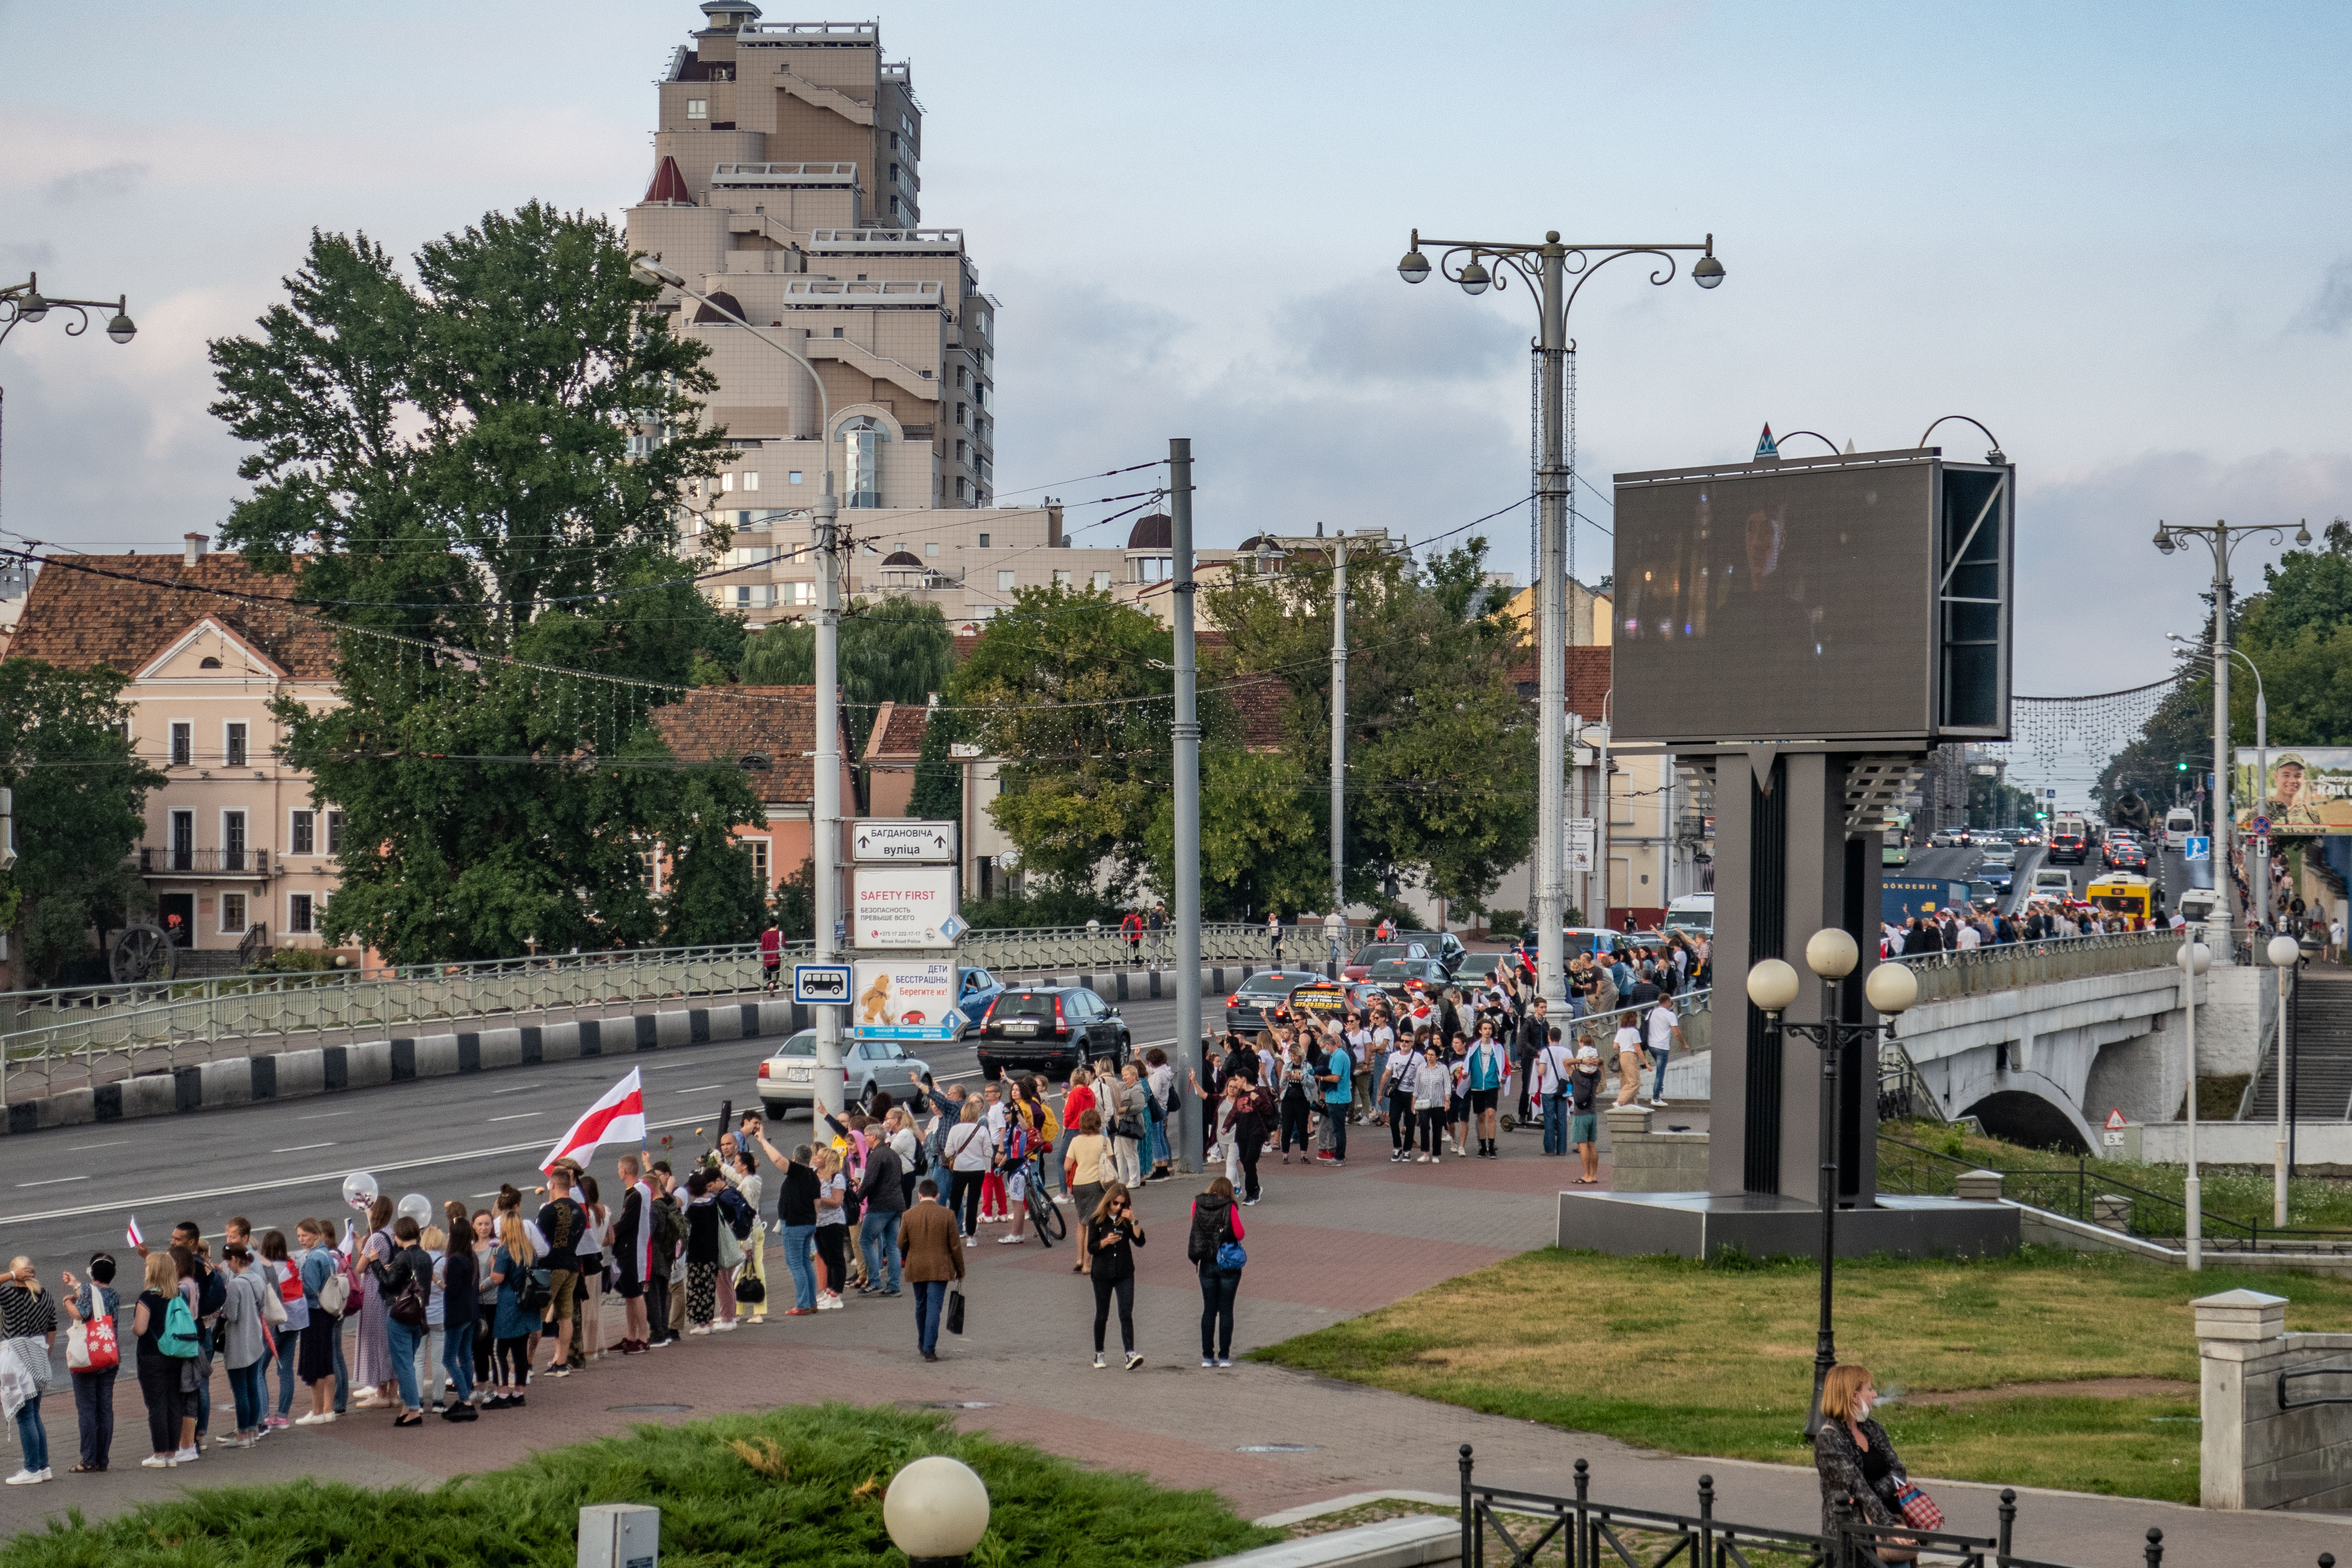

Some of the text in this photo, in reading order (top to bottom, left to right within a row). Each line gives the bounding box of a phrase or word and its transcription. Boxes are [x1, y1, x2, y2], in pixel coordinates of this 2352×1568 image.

[2318, 775, 2352, 784] Отслу
[2317, 785, 2347, 795] КАК
[871, 830, 933, 838] БАГДАНОВІЧА
[884, 845, 920, 856] вуліца
[861, 891, 935, 900] SAFETY FIRST
[928, 965, 948, 974] ДЕТИ
[899, 987, 948, 997] Берегите их!
[2110, 1135, 2115, 1143] 5
